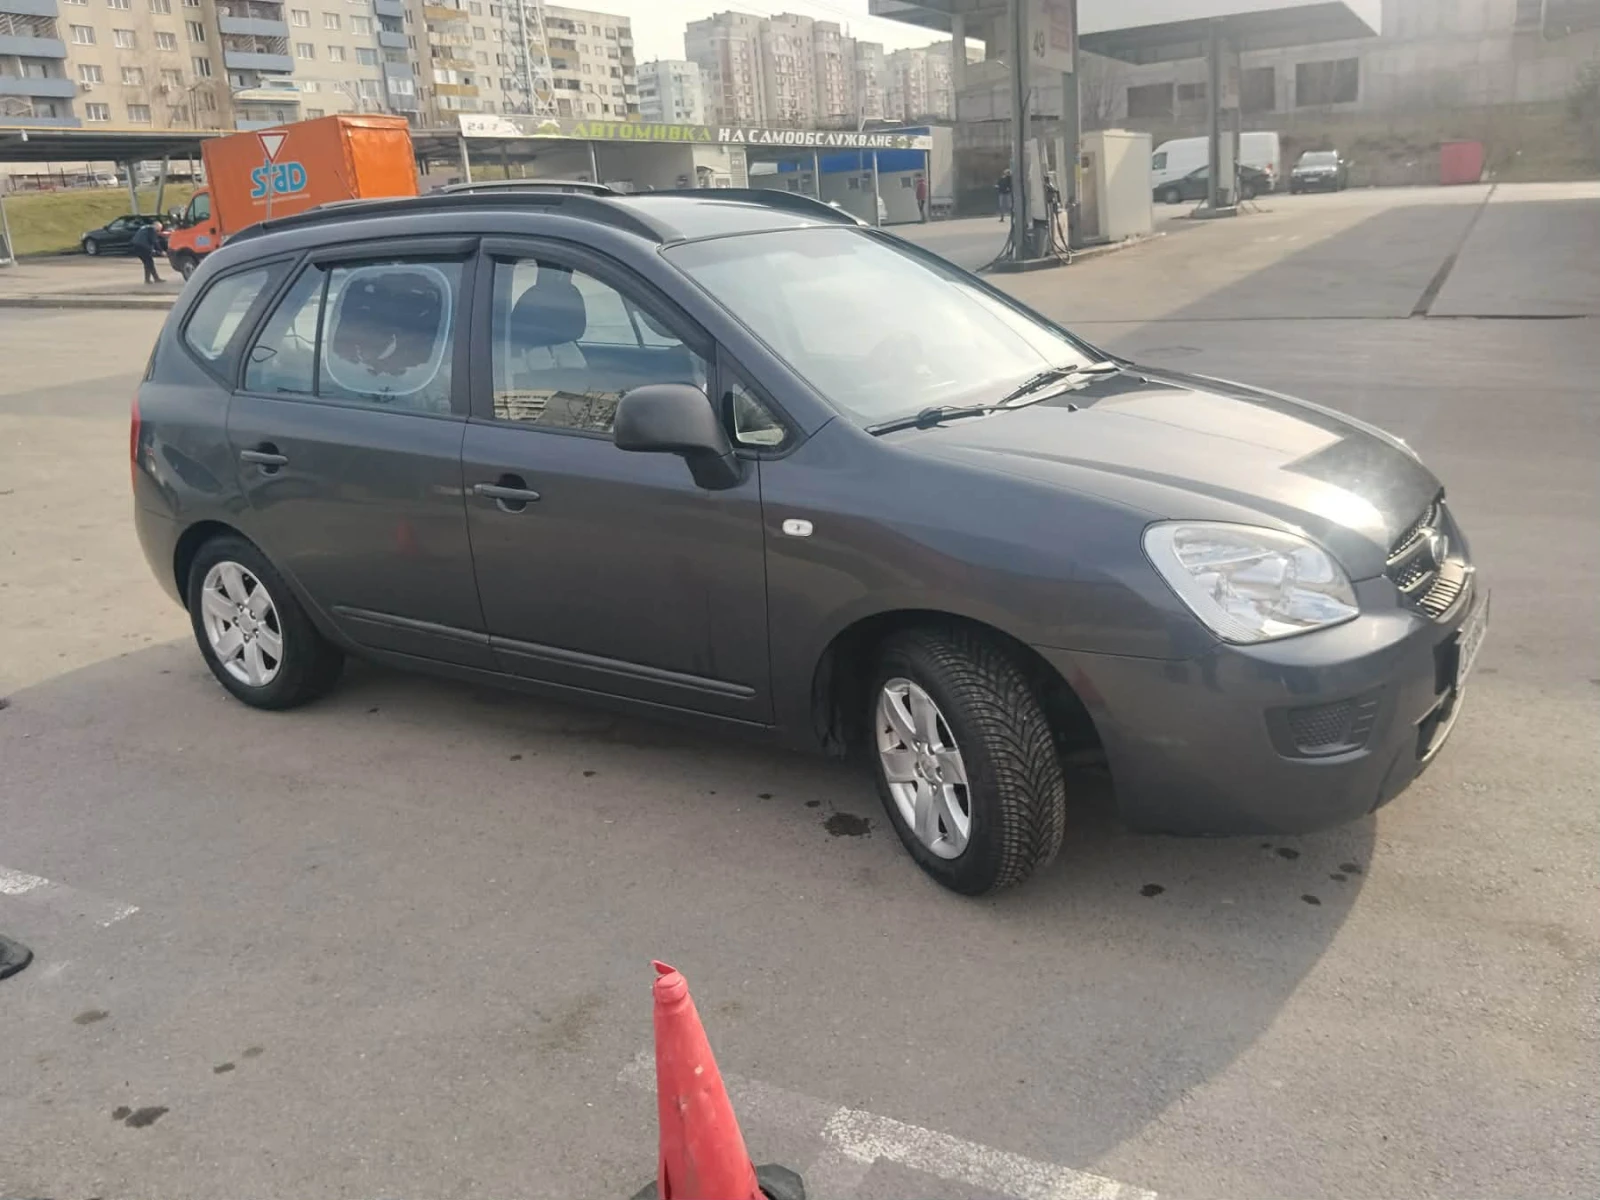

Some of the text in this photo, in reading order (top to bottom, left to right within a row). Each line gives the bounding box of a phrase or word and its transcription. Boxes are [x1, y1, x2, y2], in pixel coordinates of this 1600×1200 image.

[571, 122, 893, 148] АВТОМИВКА НА САМООБСЛУЖВАНЕ
